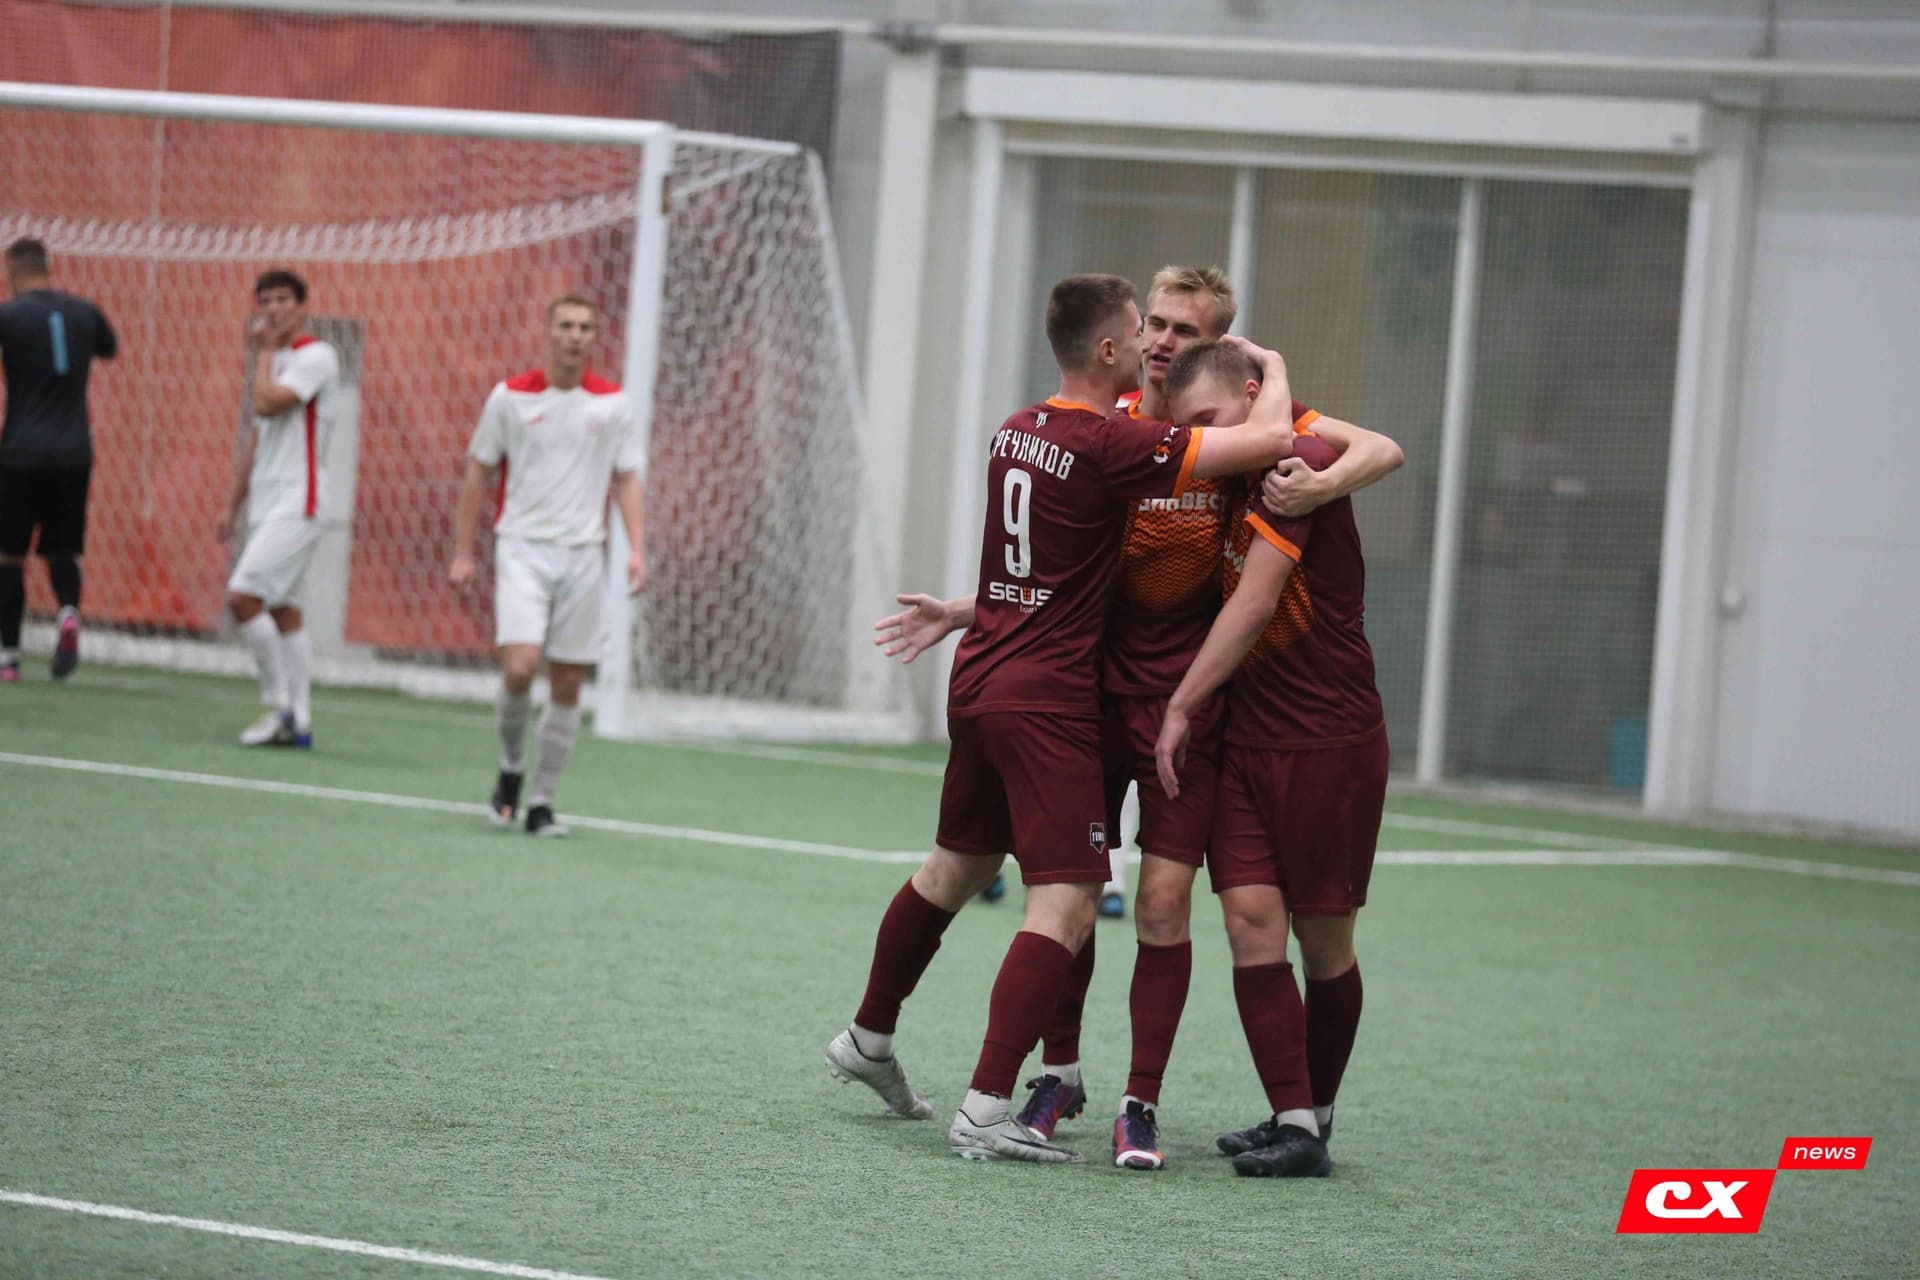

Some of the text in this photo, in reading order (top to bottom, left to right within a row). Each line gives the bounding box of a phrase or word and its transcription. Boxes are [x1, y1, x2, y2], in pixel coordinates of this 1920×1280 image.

[48, 309, 69, 375] 1
[991, 429, 1075, 481] РЕЧНИКОВ
[1003, 467, 1032, 579] 9
[988, 581, 1054, 607] SEUS
